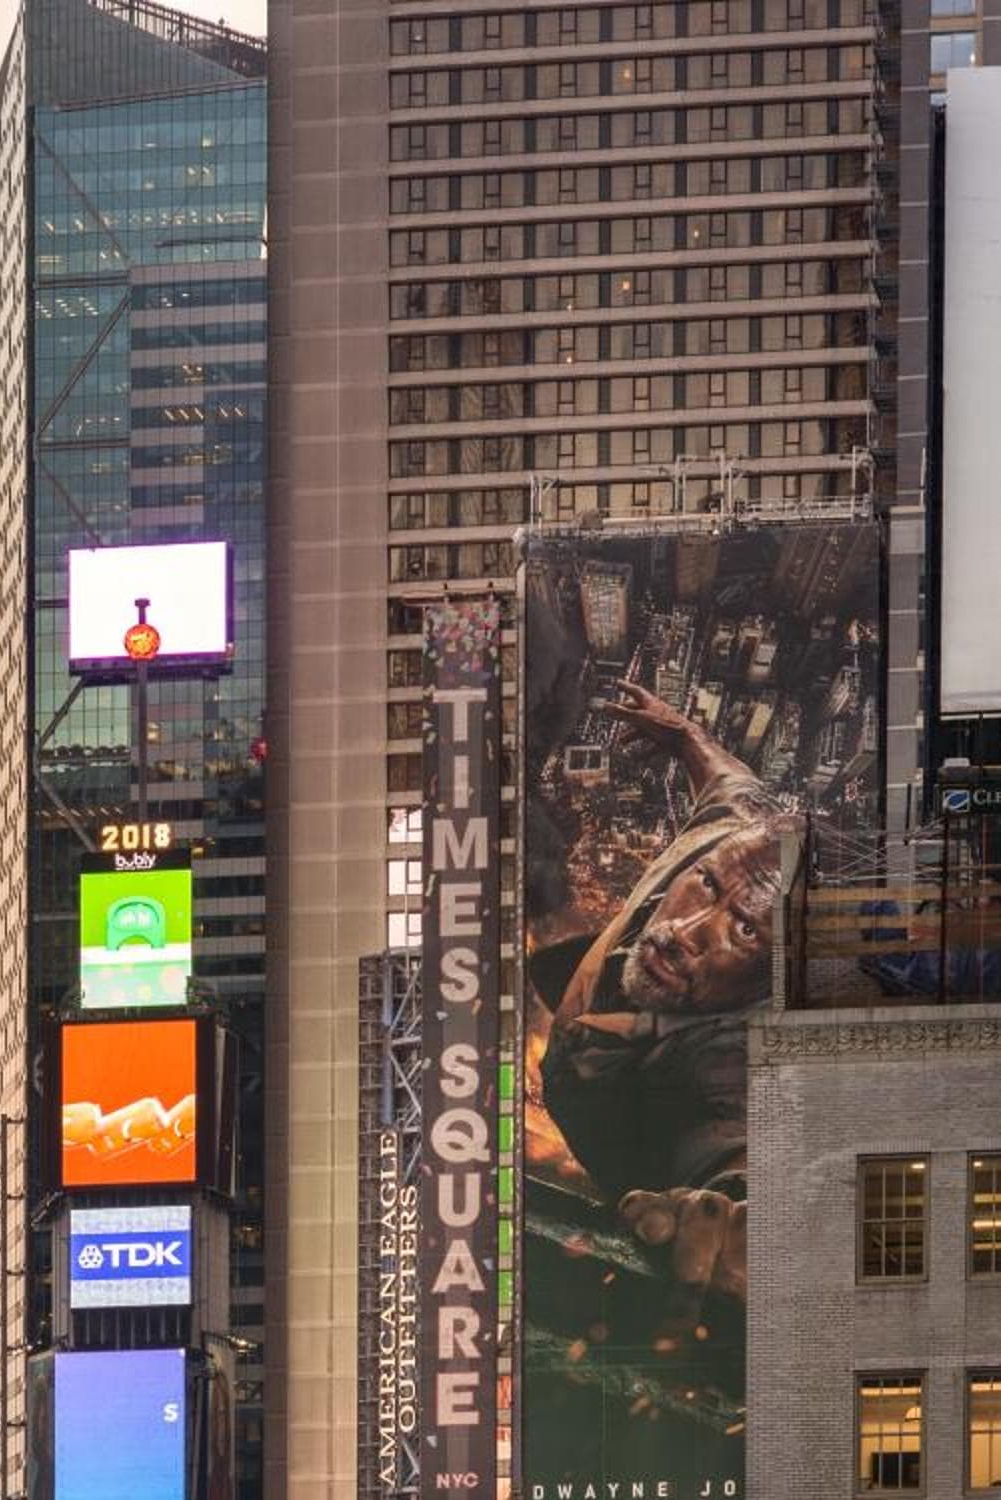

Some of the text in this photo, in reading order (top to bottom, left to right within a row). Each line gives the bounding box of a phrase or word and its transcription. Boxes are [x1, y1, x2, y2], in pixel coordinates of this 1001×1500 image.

[101, 822, 171, 851] 2018
[101, 1240, 184, 1269] TDK
[378, 1131, 399, 1490] AMERICAN EAGLE
[400, 1183, 418, 1434] OUTFITTERS
[436, 1472, 479, 1489] NYC
[532, 1480, 670, 1500] DWAYNE
